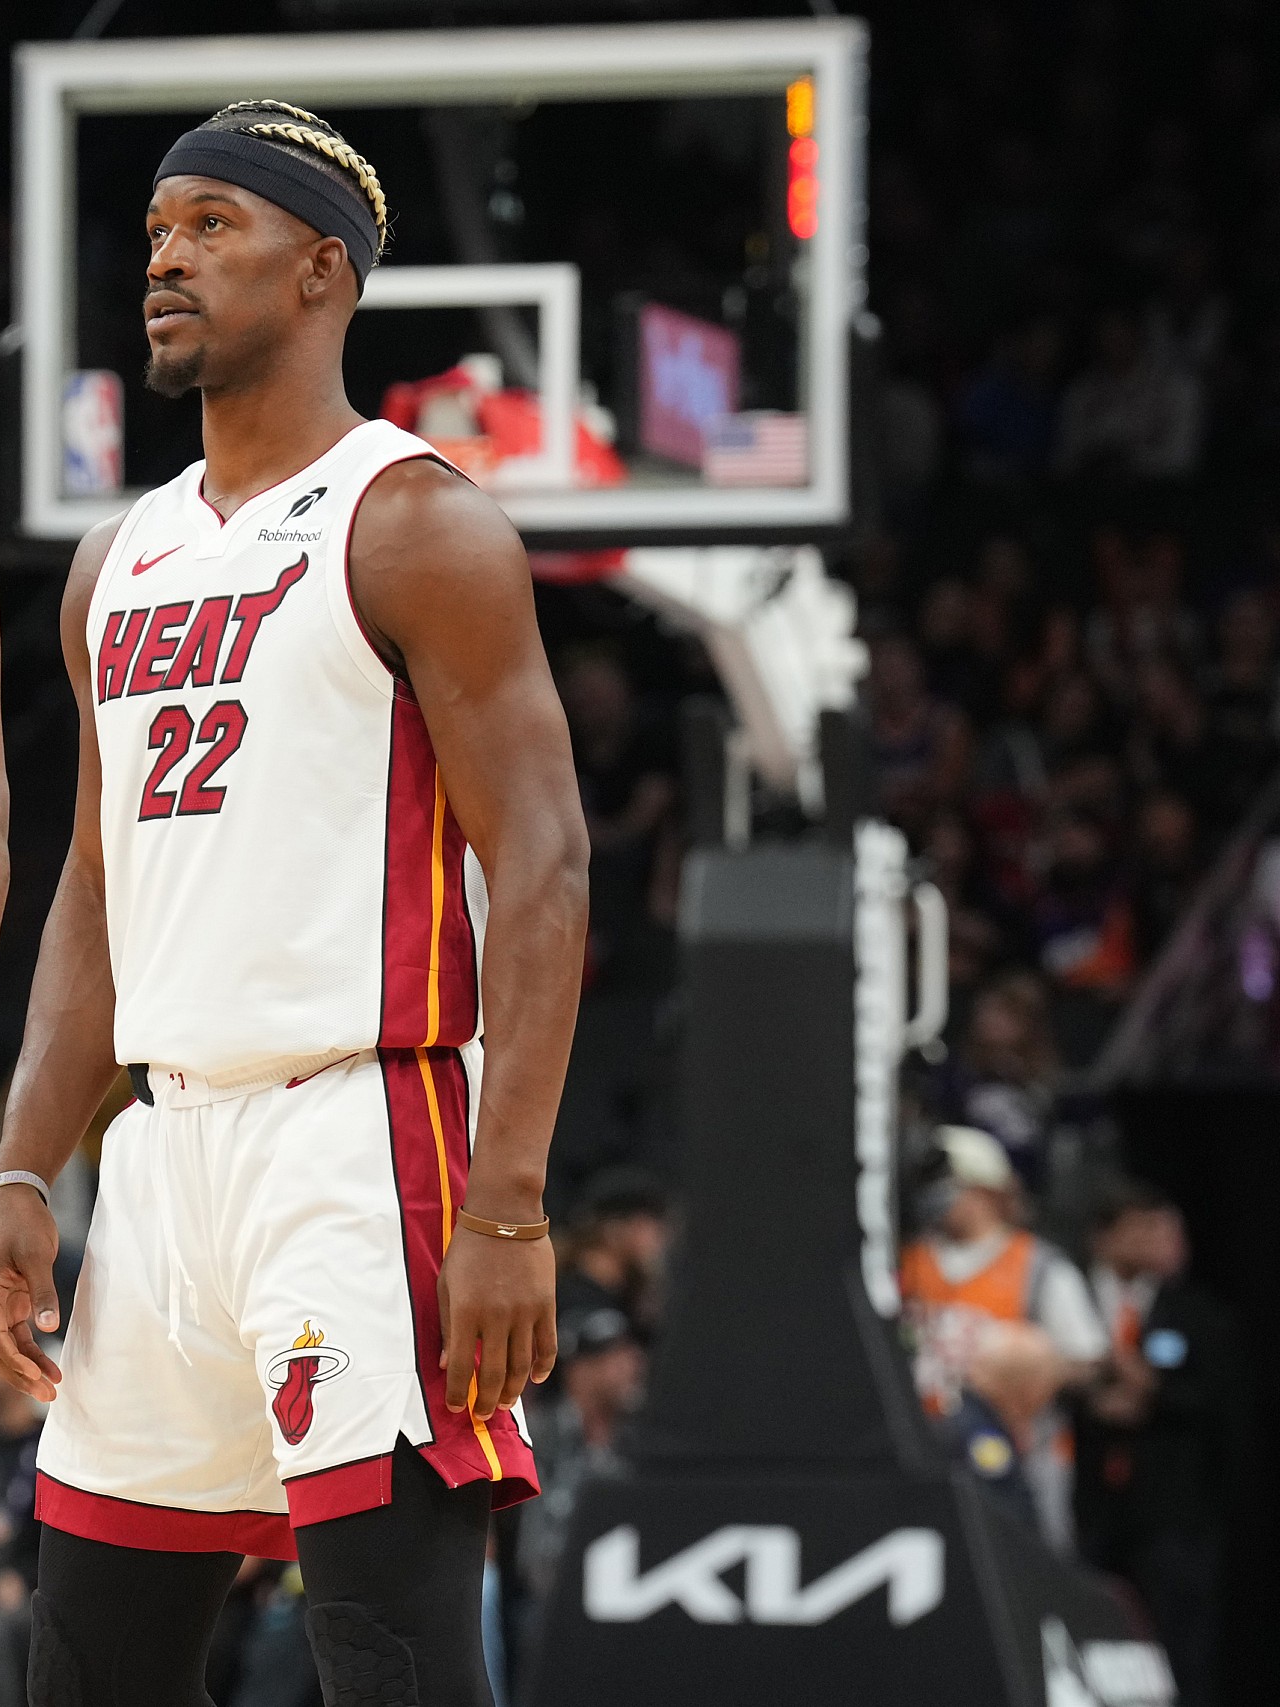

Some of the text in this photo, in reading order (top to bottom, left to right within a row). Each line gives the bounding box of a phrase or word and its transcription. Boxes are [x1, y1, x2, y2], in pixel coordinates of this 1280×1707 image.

[257, 528, 323, 542] Robinhood
[97, 551, 309, 707] HEAT
[137, 699, 249, 823] 22
[583, 1523, 947, 1627] KIA
